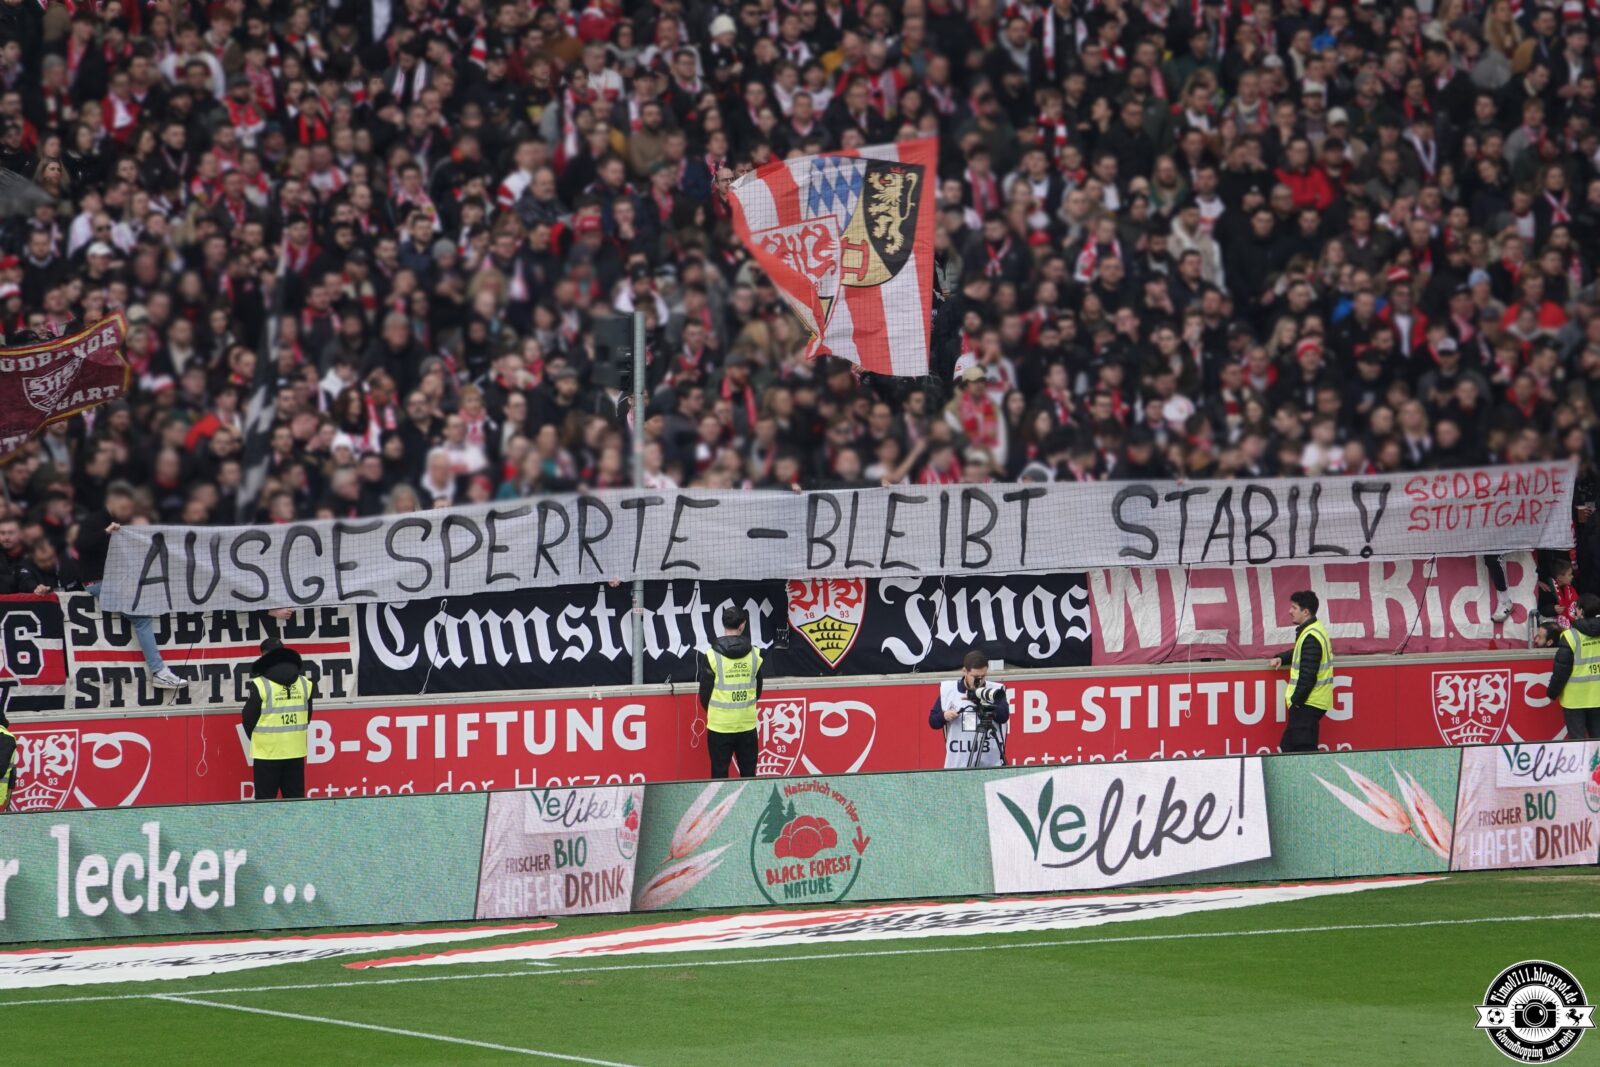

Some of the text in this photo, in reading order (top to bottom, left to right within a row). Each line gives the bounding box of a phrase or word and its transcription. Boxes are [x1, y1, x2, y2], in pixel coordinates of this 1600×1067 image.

[1404, 466, 1569, 501] SÜDBANDE
[1111, 482, 1391, 565] STABIL!
[1407, 499, 1561, 532] STUTTGART
[803, 609, 851, 620] 18 93
[879, 576, 1091, 666] Jungs
[74, 658, 353, 709] STUTTGRT
[731, 690, 748, 702] 0899
[280, 713, 298, 725] 1243
[1451, 715, 1492, 725] 18 93
[776, 745, 787, 753] 93
[949, 739, 991, 753] CLUB
[48, 777, 58, 786] 93
[831, 790, 848, 806] von
[1478, 807, 1522, 827] FRISCHER
[1525, 790, 1556, 822] BIO
[997, 757, 1248, 876] Velike!
[50, 821, 247, 918] lecker
[505, 836, 587, 874] FRISCHER BIO
[765, 855, 851, 886] BLACK FOREST
[783, 877, 834, 899] NATURE
